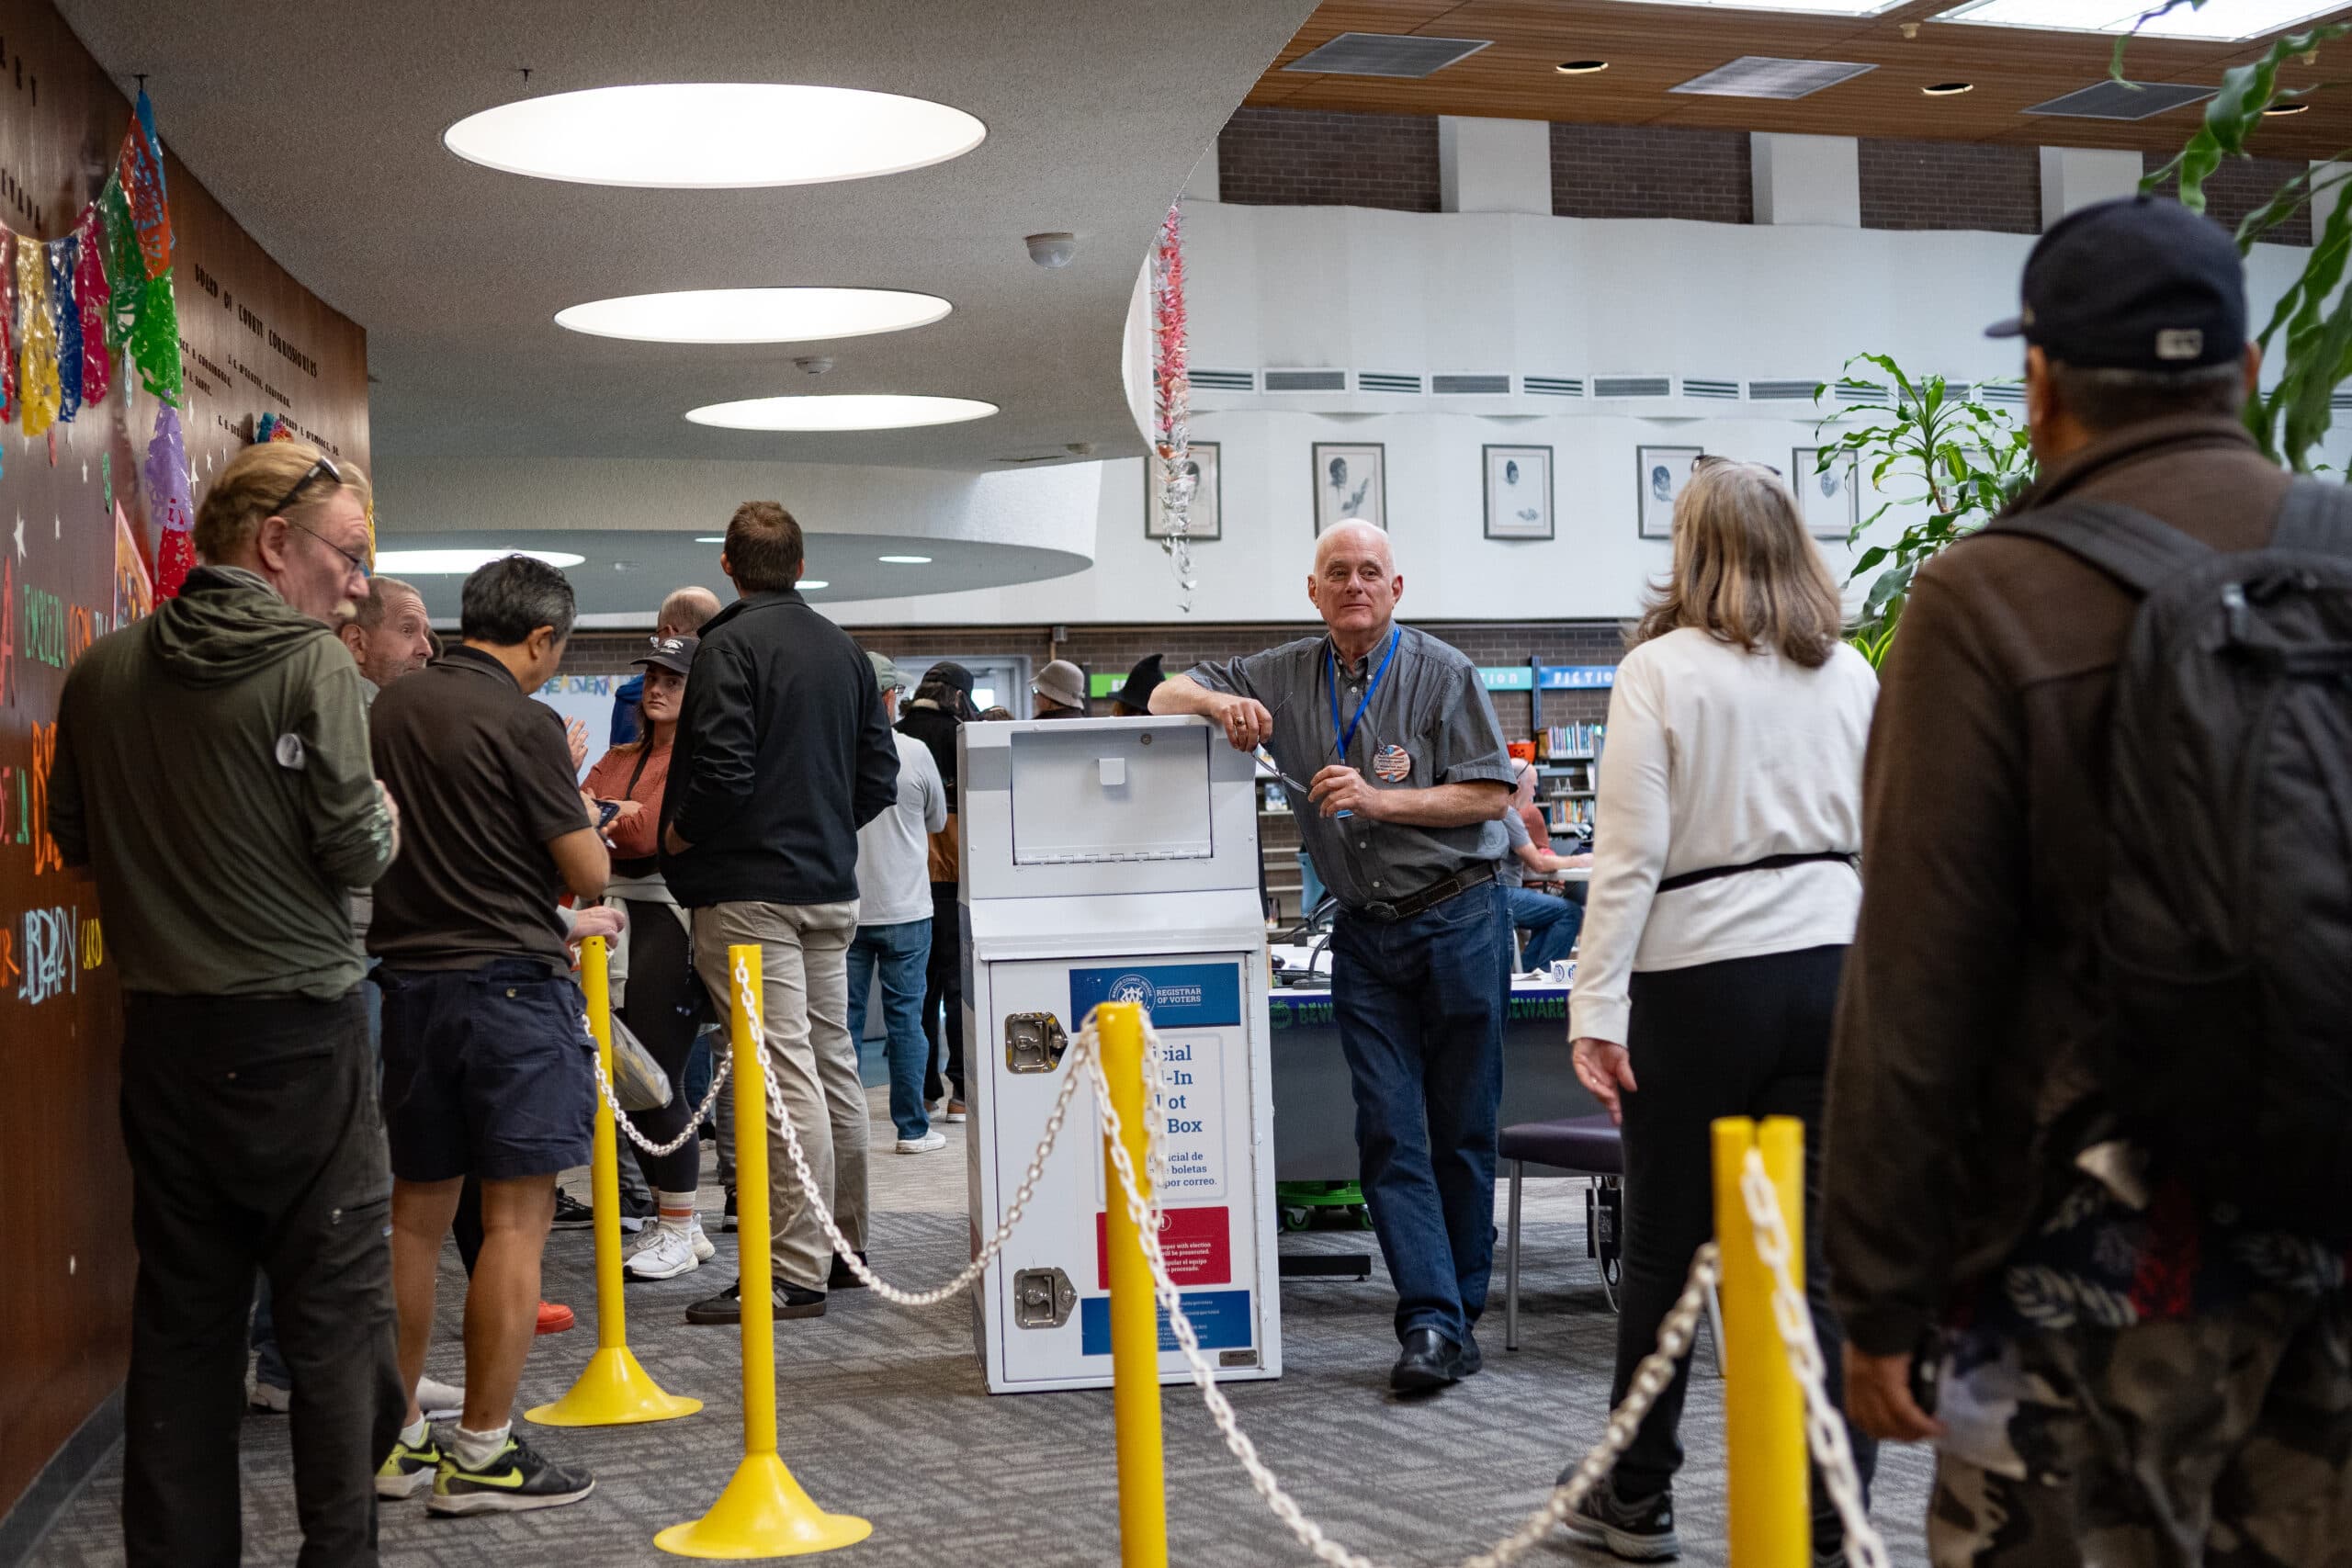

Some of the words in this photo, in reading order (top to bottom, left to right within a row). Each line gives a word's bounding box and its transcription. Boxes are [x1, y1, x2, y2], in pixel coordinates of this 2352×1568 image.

[1156, 987, 1202, 997] REGISTRAR
[1167, 1118, 1203, 1134] Box
[1191, 1151, 1204, 1161] de
[1171, 1164, 1207, 1175] boletas
[1183, 1178, 1217, 1187] correo.
